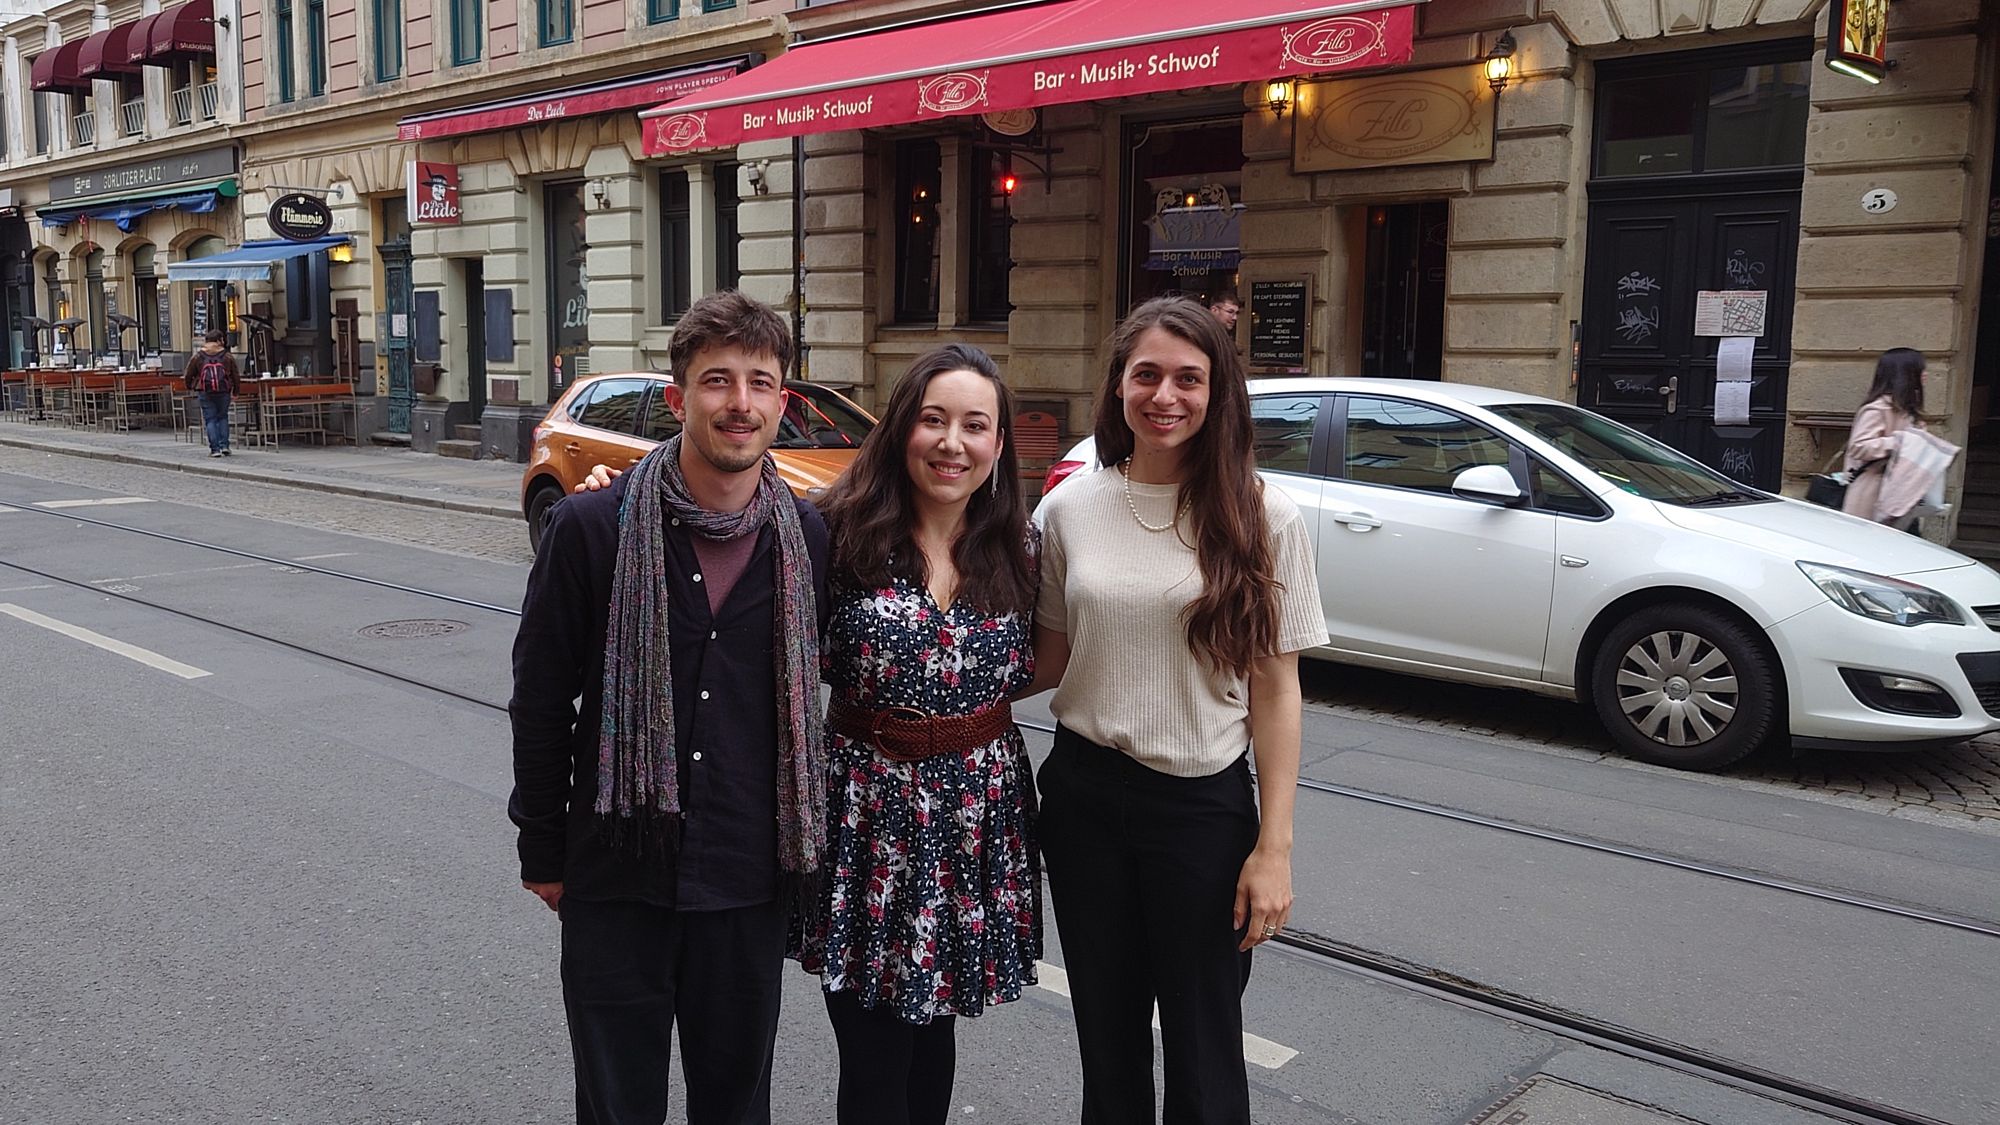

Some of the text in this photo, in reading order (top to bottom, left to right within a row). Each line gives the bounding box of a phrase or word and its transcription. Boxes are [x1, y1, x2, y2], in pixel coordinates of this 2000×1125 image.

[1307, 28, 1355, 56] Zille
[1034, 46, 1220, 91] Bar Musik Schwof
[655, 84, 673, 95] JOHN
[674, 80, 701, 91] PLAYER
[701, 75, 726, 87] SPECIA
[935, 81, 966, 103] Zille
[528, 102, 566, 121] Der Lude
[743, 95, 873, 130] Bar Musik Schwof
[1349, 99, 1428, 142] Zille
[139, 166, 161, 183] PLATZ
[419, 201, 458, 219] Lude
[1872, 193, 1886, 210] 5
[1162, 251, 1223, 261] Bar Musik
[1172, 264, 1210, 276] Schwof
